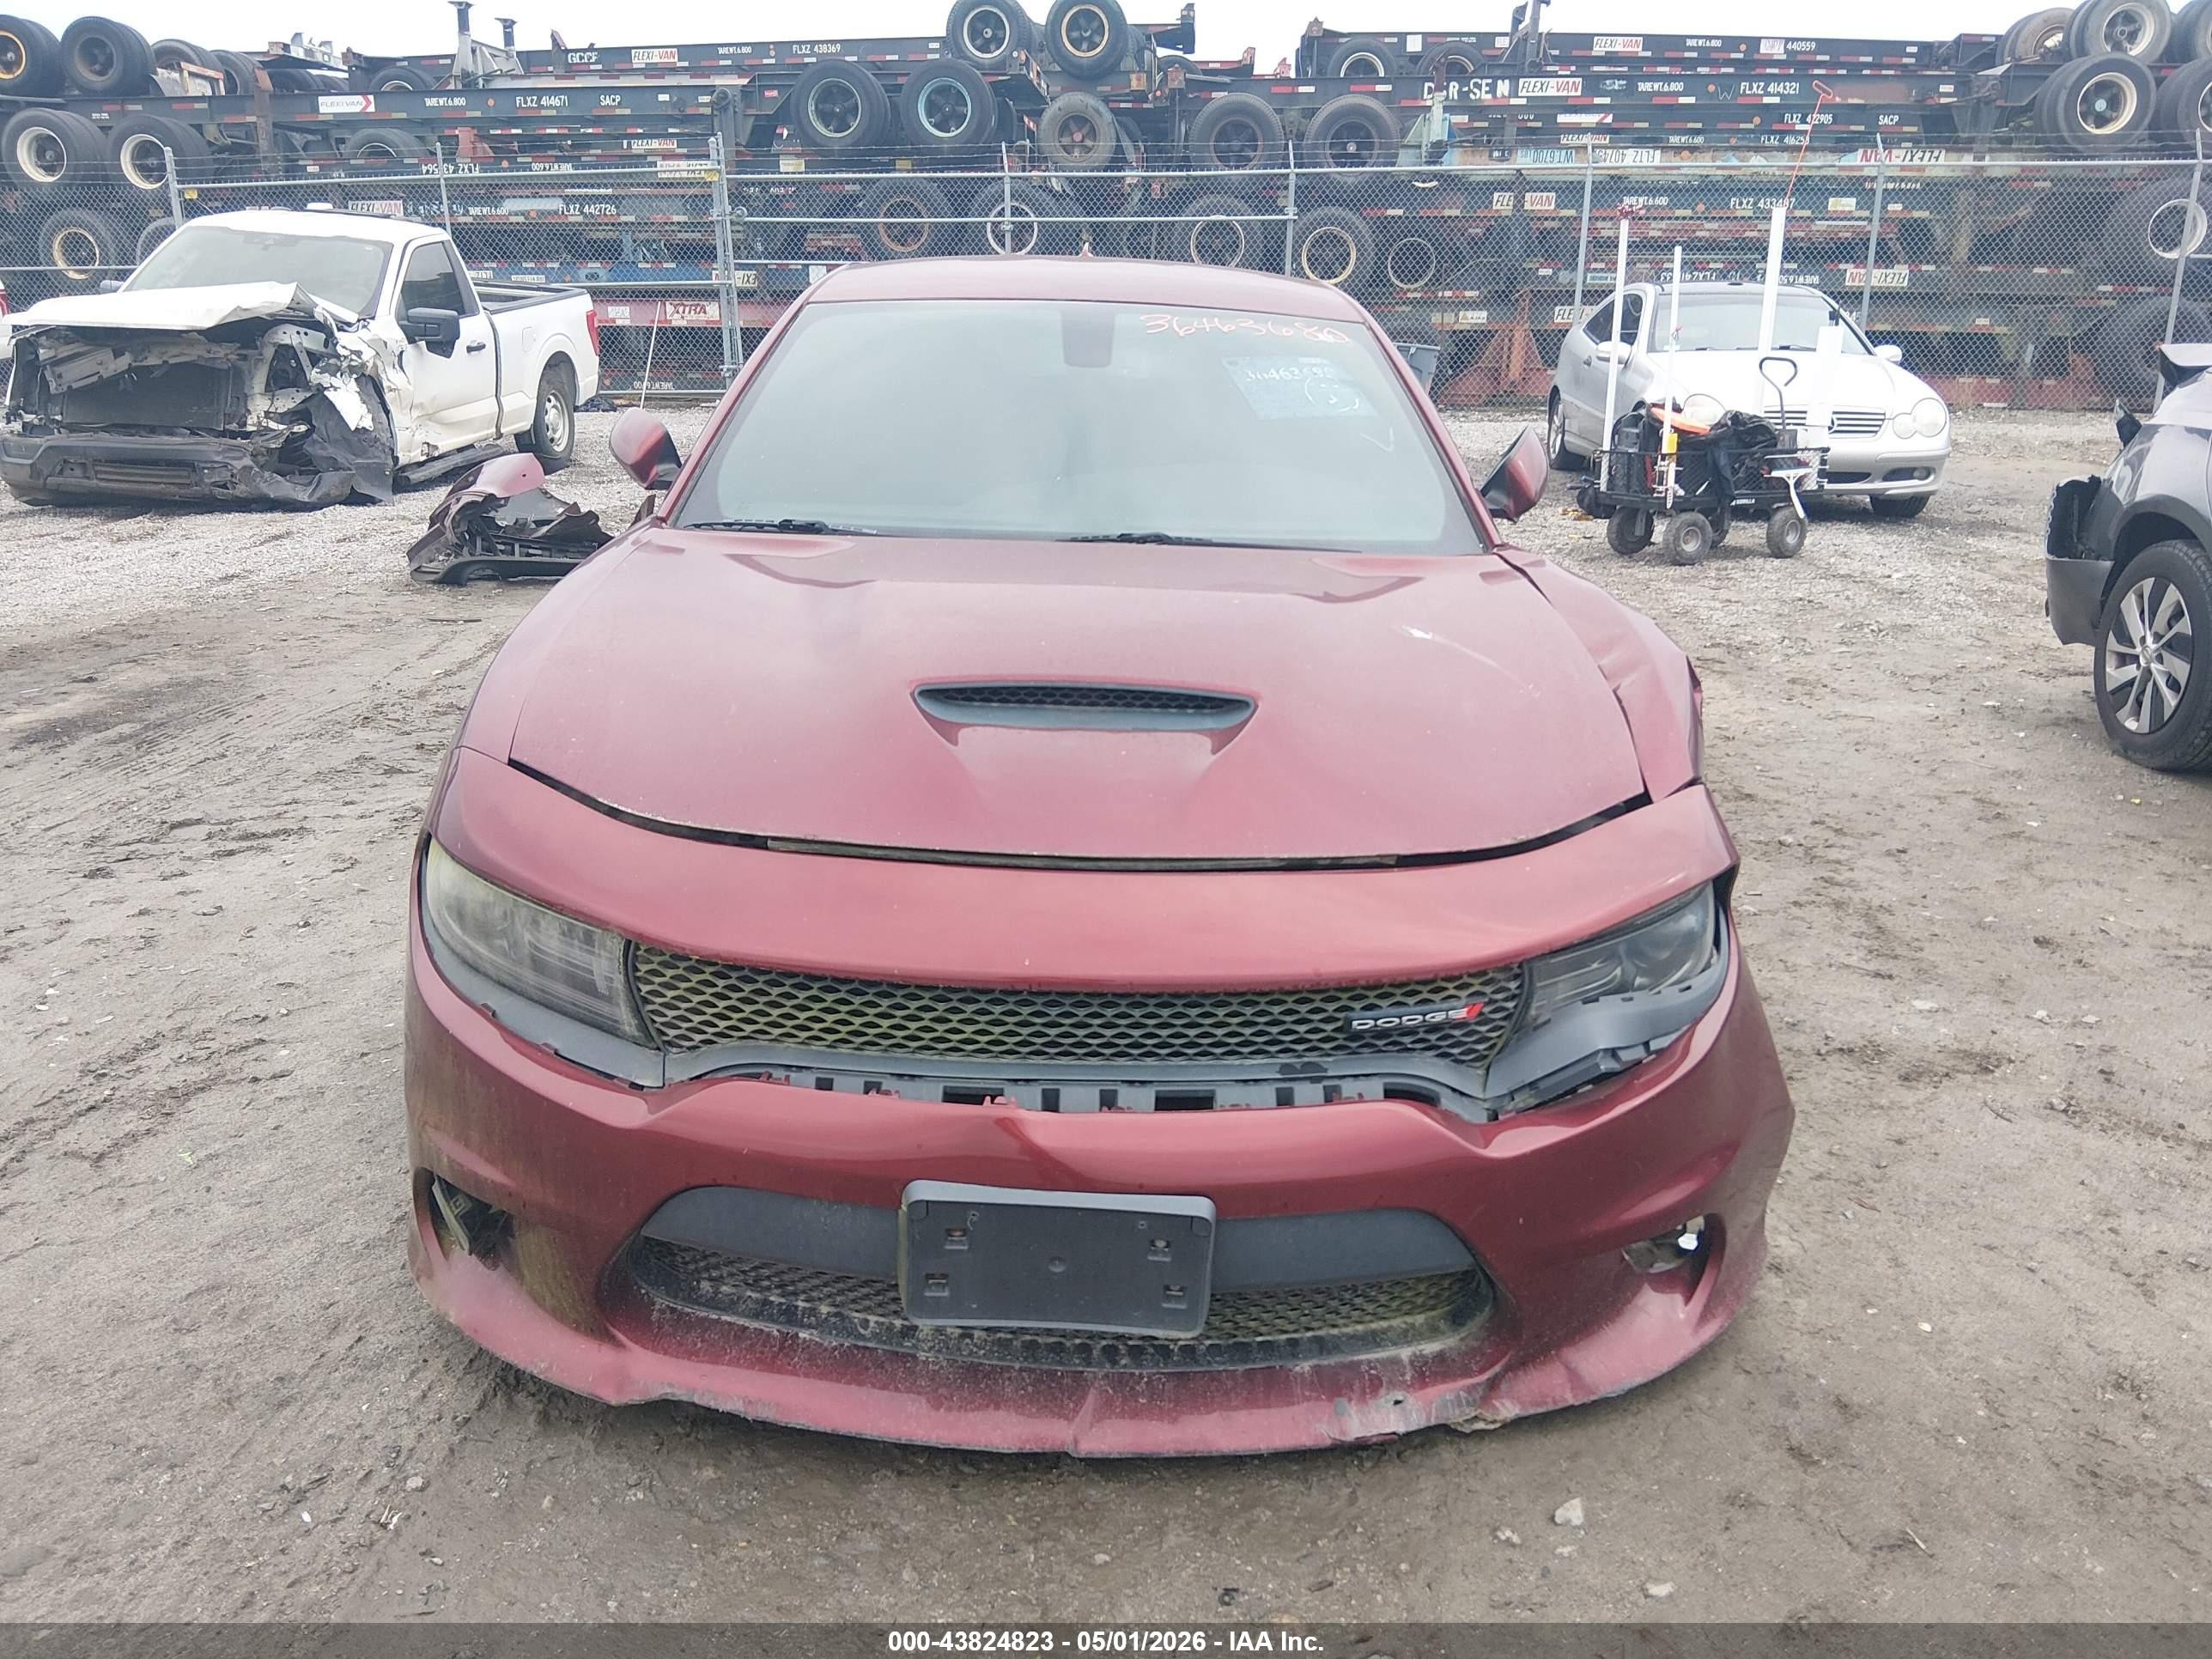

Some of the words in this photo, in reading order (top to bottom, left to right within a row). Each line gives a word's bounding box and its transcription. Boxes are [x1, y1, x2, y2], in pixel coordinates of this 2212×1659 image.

[793, 44, 811, 54] FLXZ
[1595, 38, 1641, 49] FLEXI-VAN
[1786, 40, 1816, 52] 440559
[633, 50, 677, 61] FLEXI-VAN
[1520, 81, 1581, 94] FLEXI-VAN
[1740, 82, 1765, 94] FLXZ
[1767, 82, 1799, 94] 414321
[516, 96, 538, 108] FLXZ
[540, 95, 568, 107] 414671
[599, 94, 621, 106] SACP
[1784, 112, 1802, 124] FLXZ
[1878, 114, 1899, 125] SACP
[1760, 135, 1780, 144] FLXZ
[422, 162, 454, 175] 43564
[458, 162, 479, 174] FLXZ
[559, 204, 580, 215] FLXZ
[583, 204, 617, 215] 442726
[1730, 197, 1754, 210] FLXZ
[1848, 271, 1907, 283] FLEXI-AN
[669, 301, 708, 317] XTRA
[1352, 1008, 1468, 1030] DODGE
